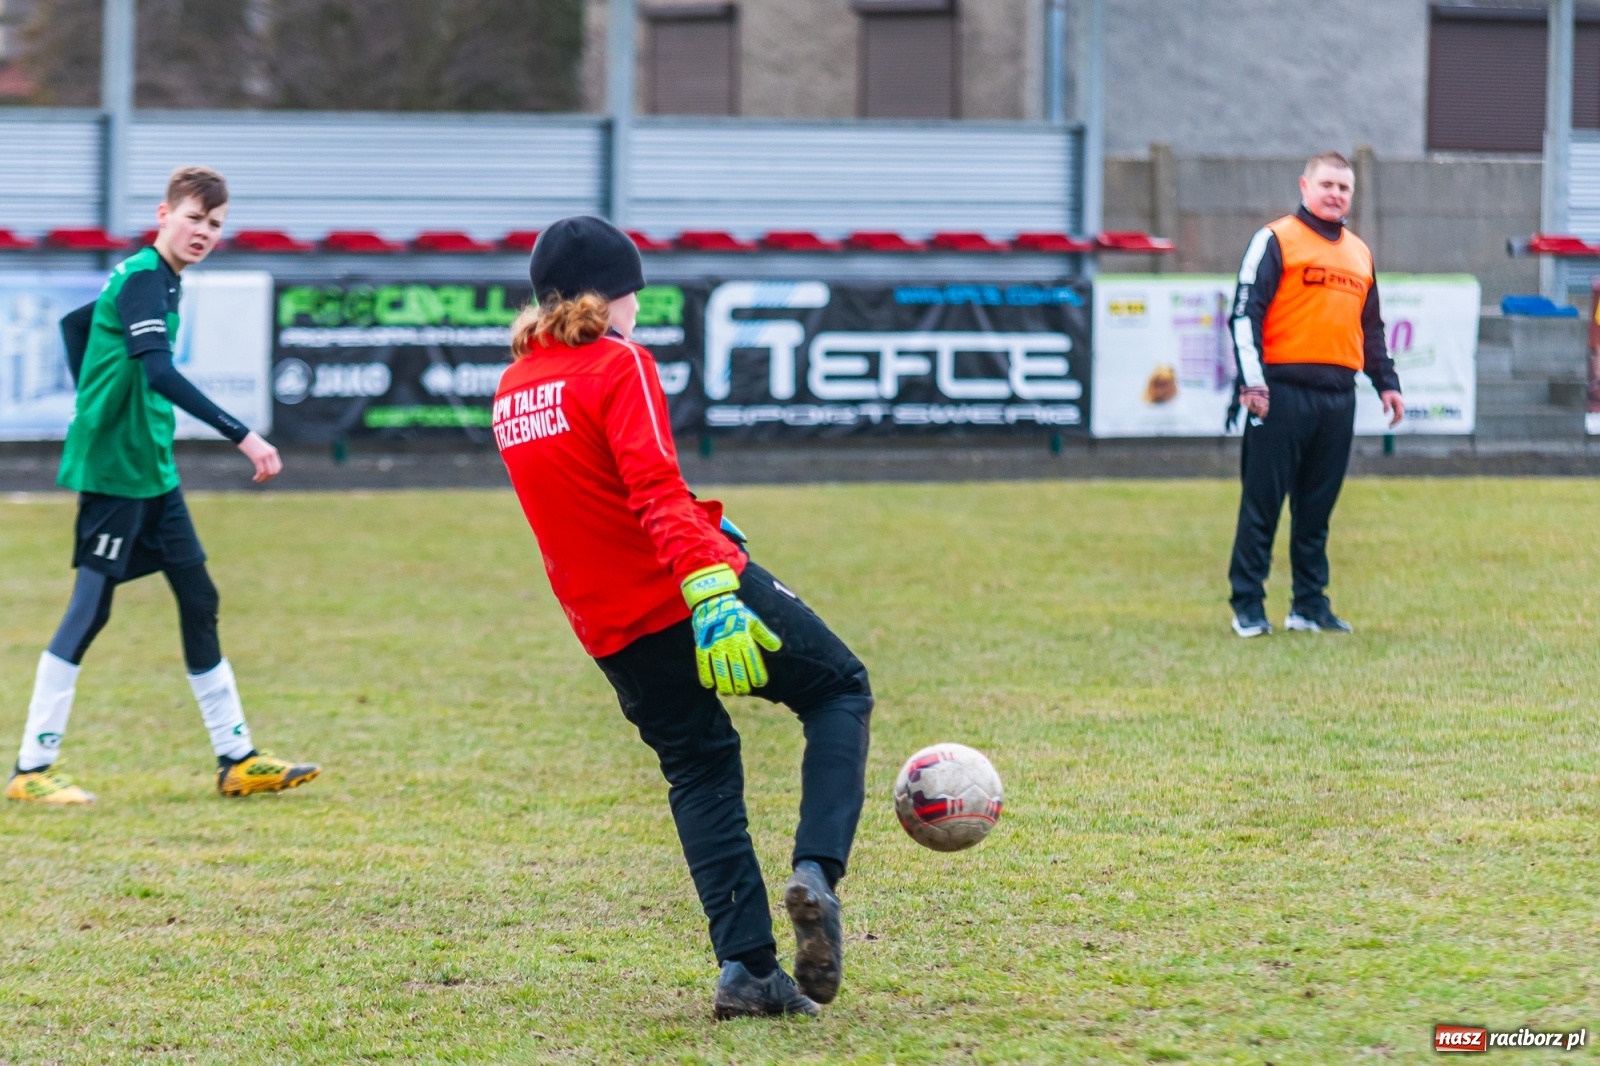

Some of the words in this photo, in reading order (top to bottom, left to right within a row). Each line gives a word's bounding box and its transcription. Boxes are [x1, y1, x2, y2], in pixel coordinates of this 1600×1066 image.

[493, 395, 512, 424] APN
[514, 381, 566, 416] TALENT
[494, 406, 571, 451] TRZEBNICA
[92, 533, 123, 560] 11
